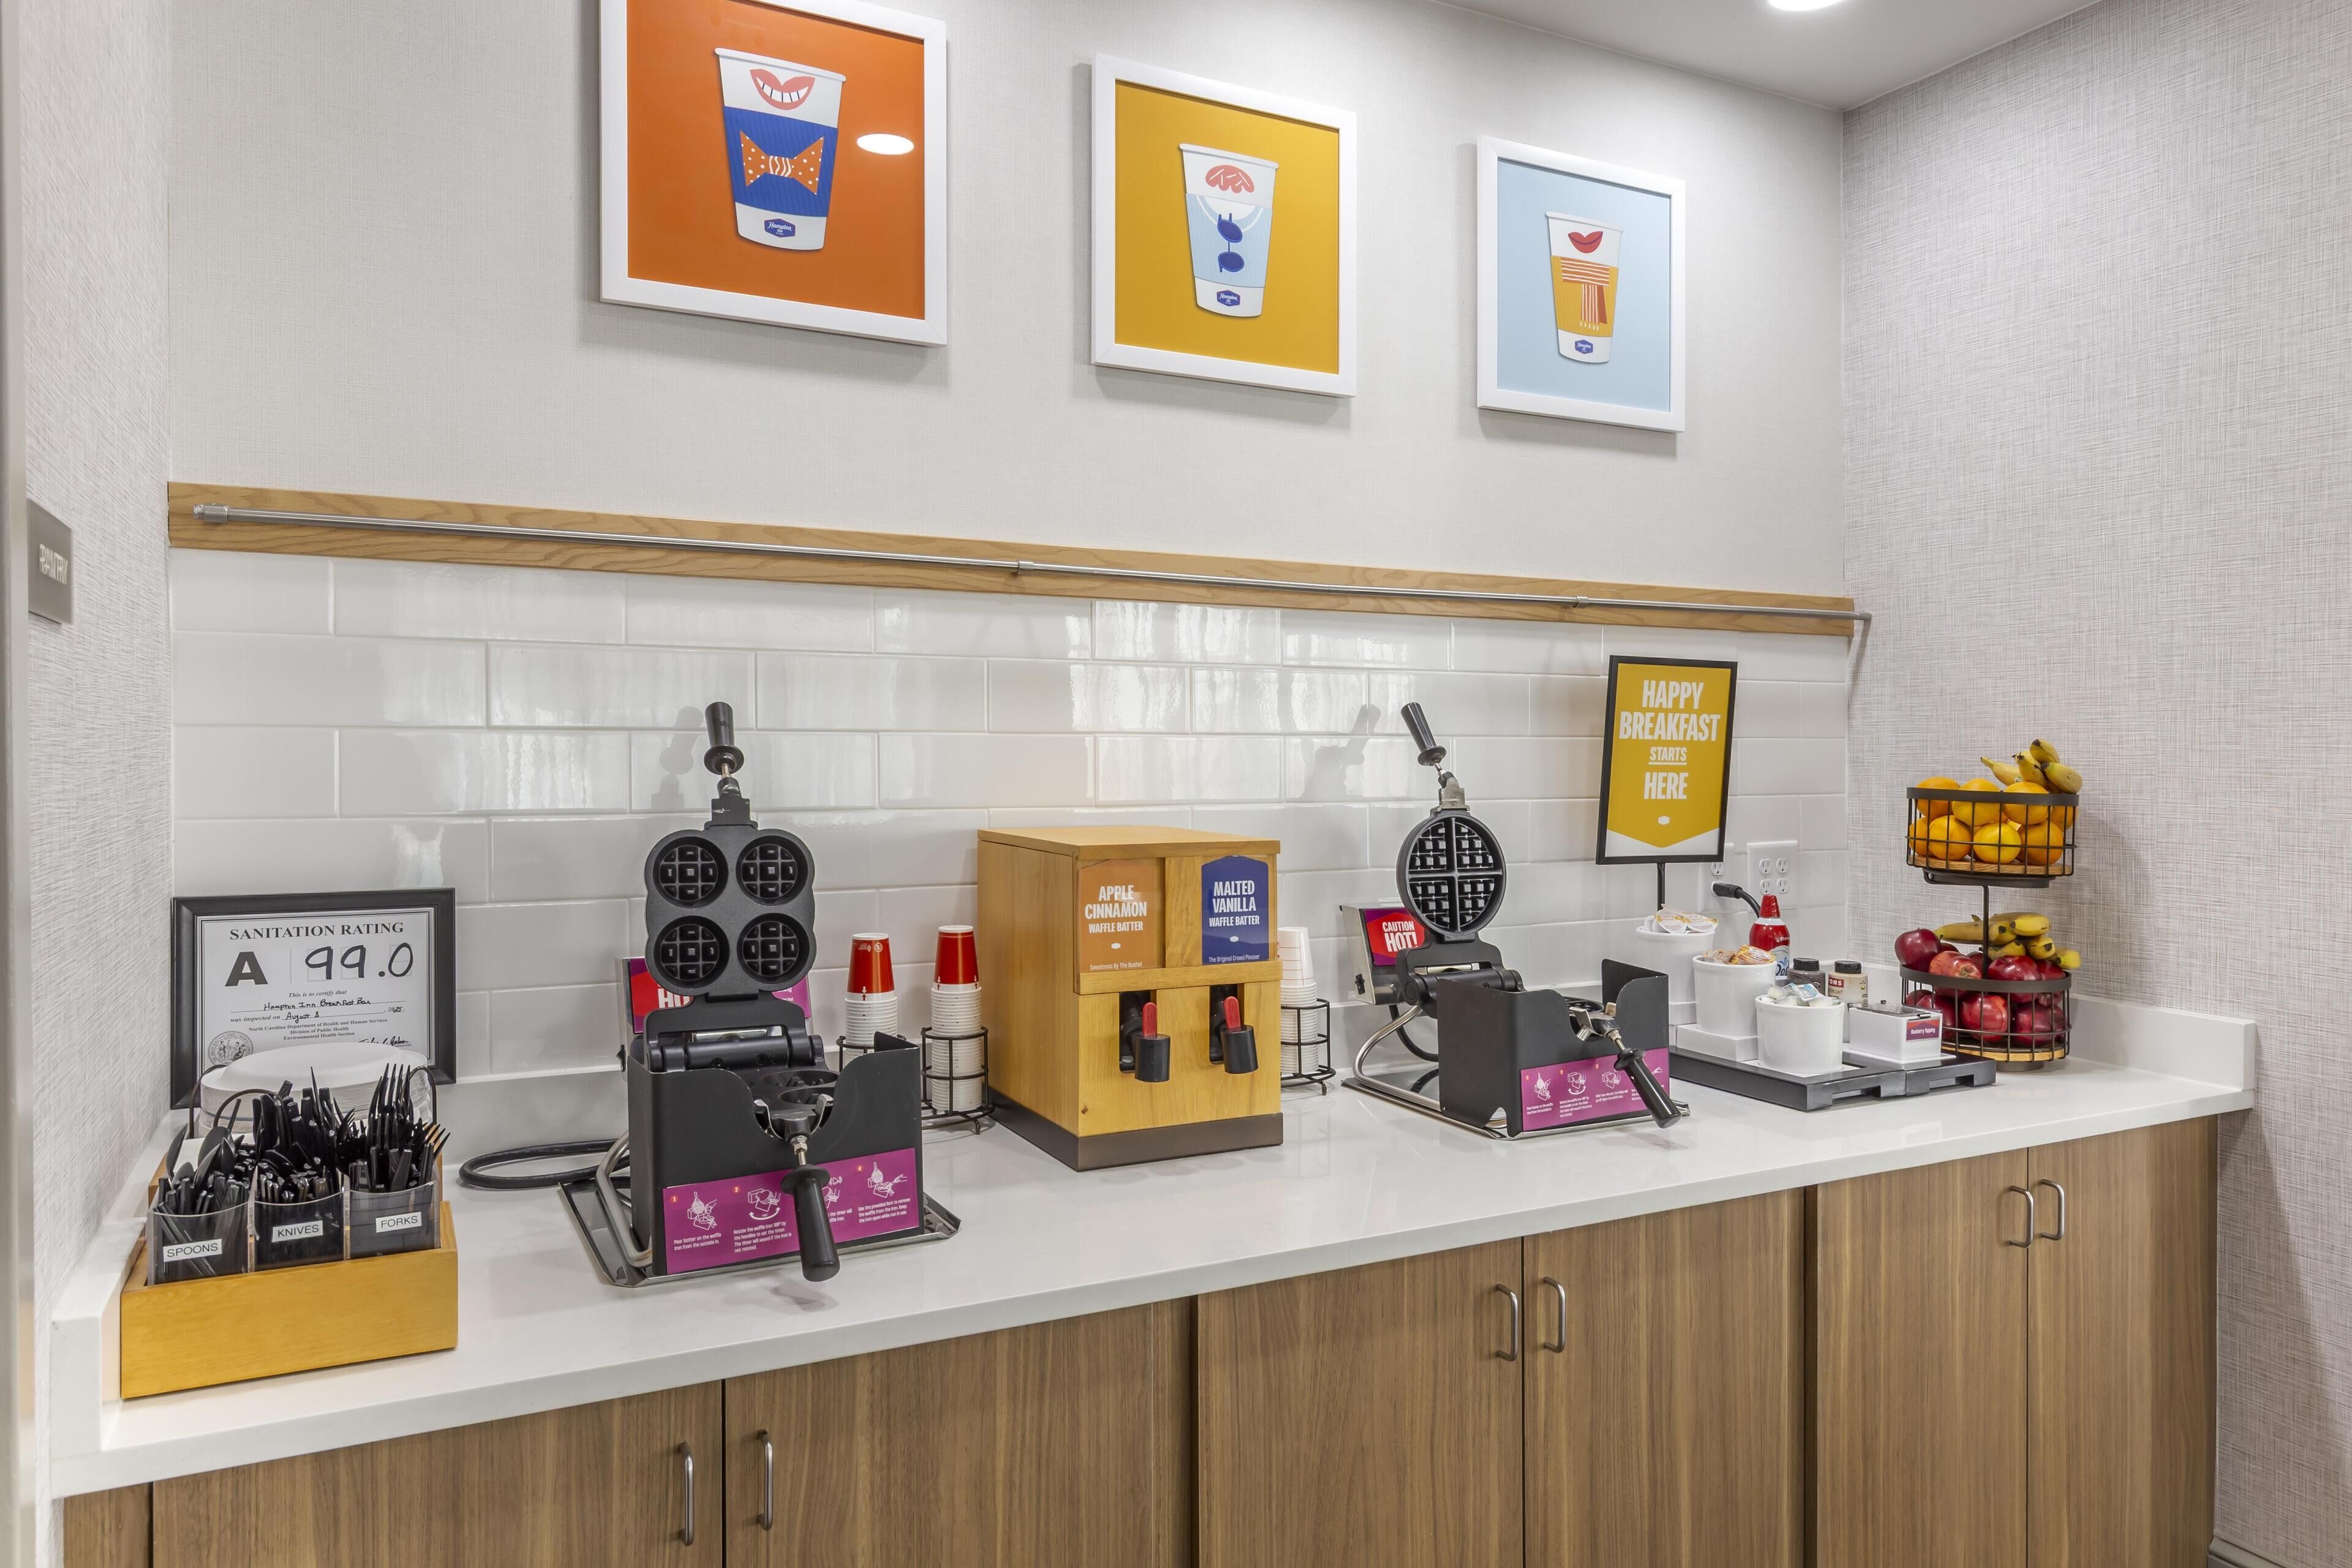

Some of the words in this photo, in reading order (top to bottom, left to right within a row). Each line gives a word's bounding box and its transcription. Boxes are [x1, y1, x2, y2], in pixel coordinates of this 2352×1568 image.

[767, 221, 793, 232] Hampton
[39, 544, 69, 585] PANTRY
[1642, 679, 1704, 709] HAPPY
[1619, 711, 1721, 742] BREAKFAST
[1649, 746, 1687, 761] STARTS
[1643, 772, 1689, 799] HERE
[1098, 885, 1134, 902] APPLE
[1213, 880, 1255, 897] MALTED
[1085, 902, 1147, 919] CINNAMON
[1213, 897, 1256, 913] VANILLA
[1088, 922, 1115, 933] WAFFLE
[1117, 921, 1143, 932] BATTER
[1209, 916, 1234, 927] WAFFLE
[1235, 915, 1260, 925] BATTER
[1382, 921, 1415, 932] CAUTION
[230, 925, 335, 940] SANITATION
[341, 922, 404, 935] RATING
[1384, 931, 1419, 952] HOT!
[225, 951, 268, 987] A
[305, 942, 413, 980] 99.0
[263, 1002, 295, 1011] Hampton
[285, 1012, 310, 1023] August
[381, 1215, 418, 1228] FORKS
[277, 1224, 319, 1238] KNIVES
[167, 1243, 219, 1257] SPOONS
